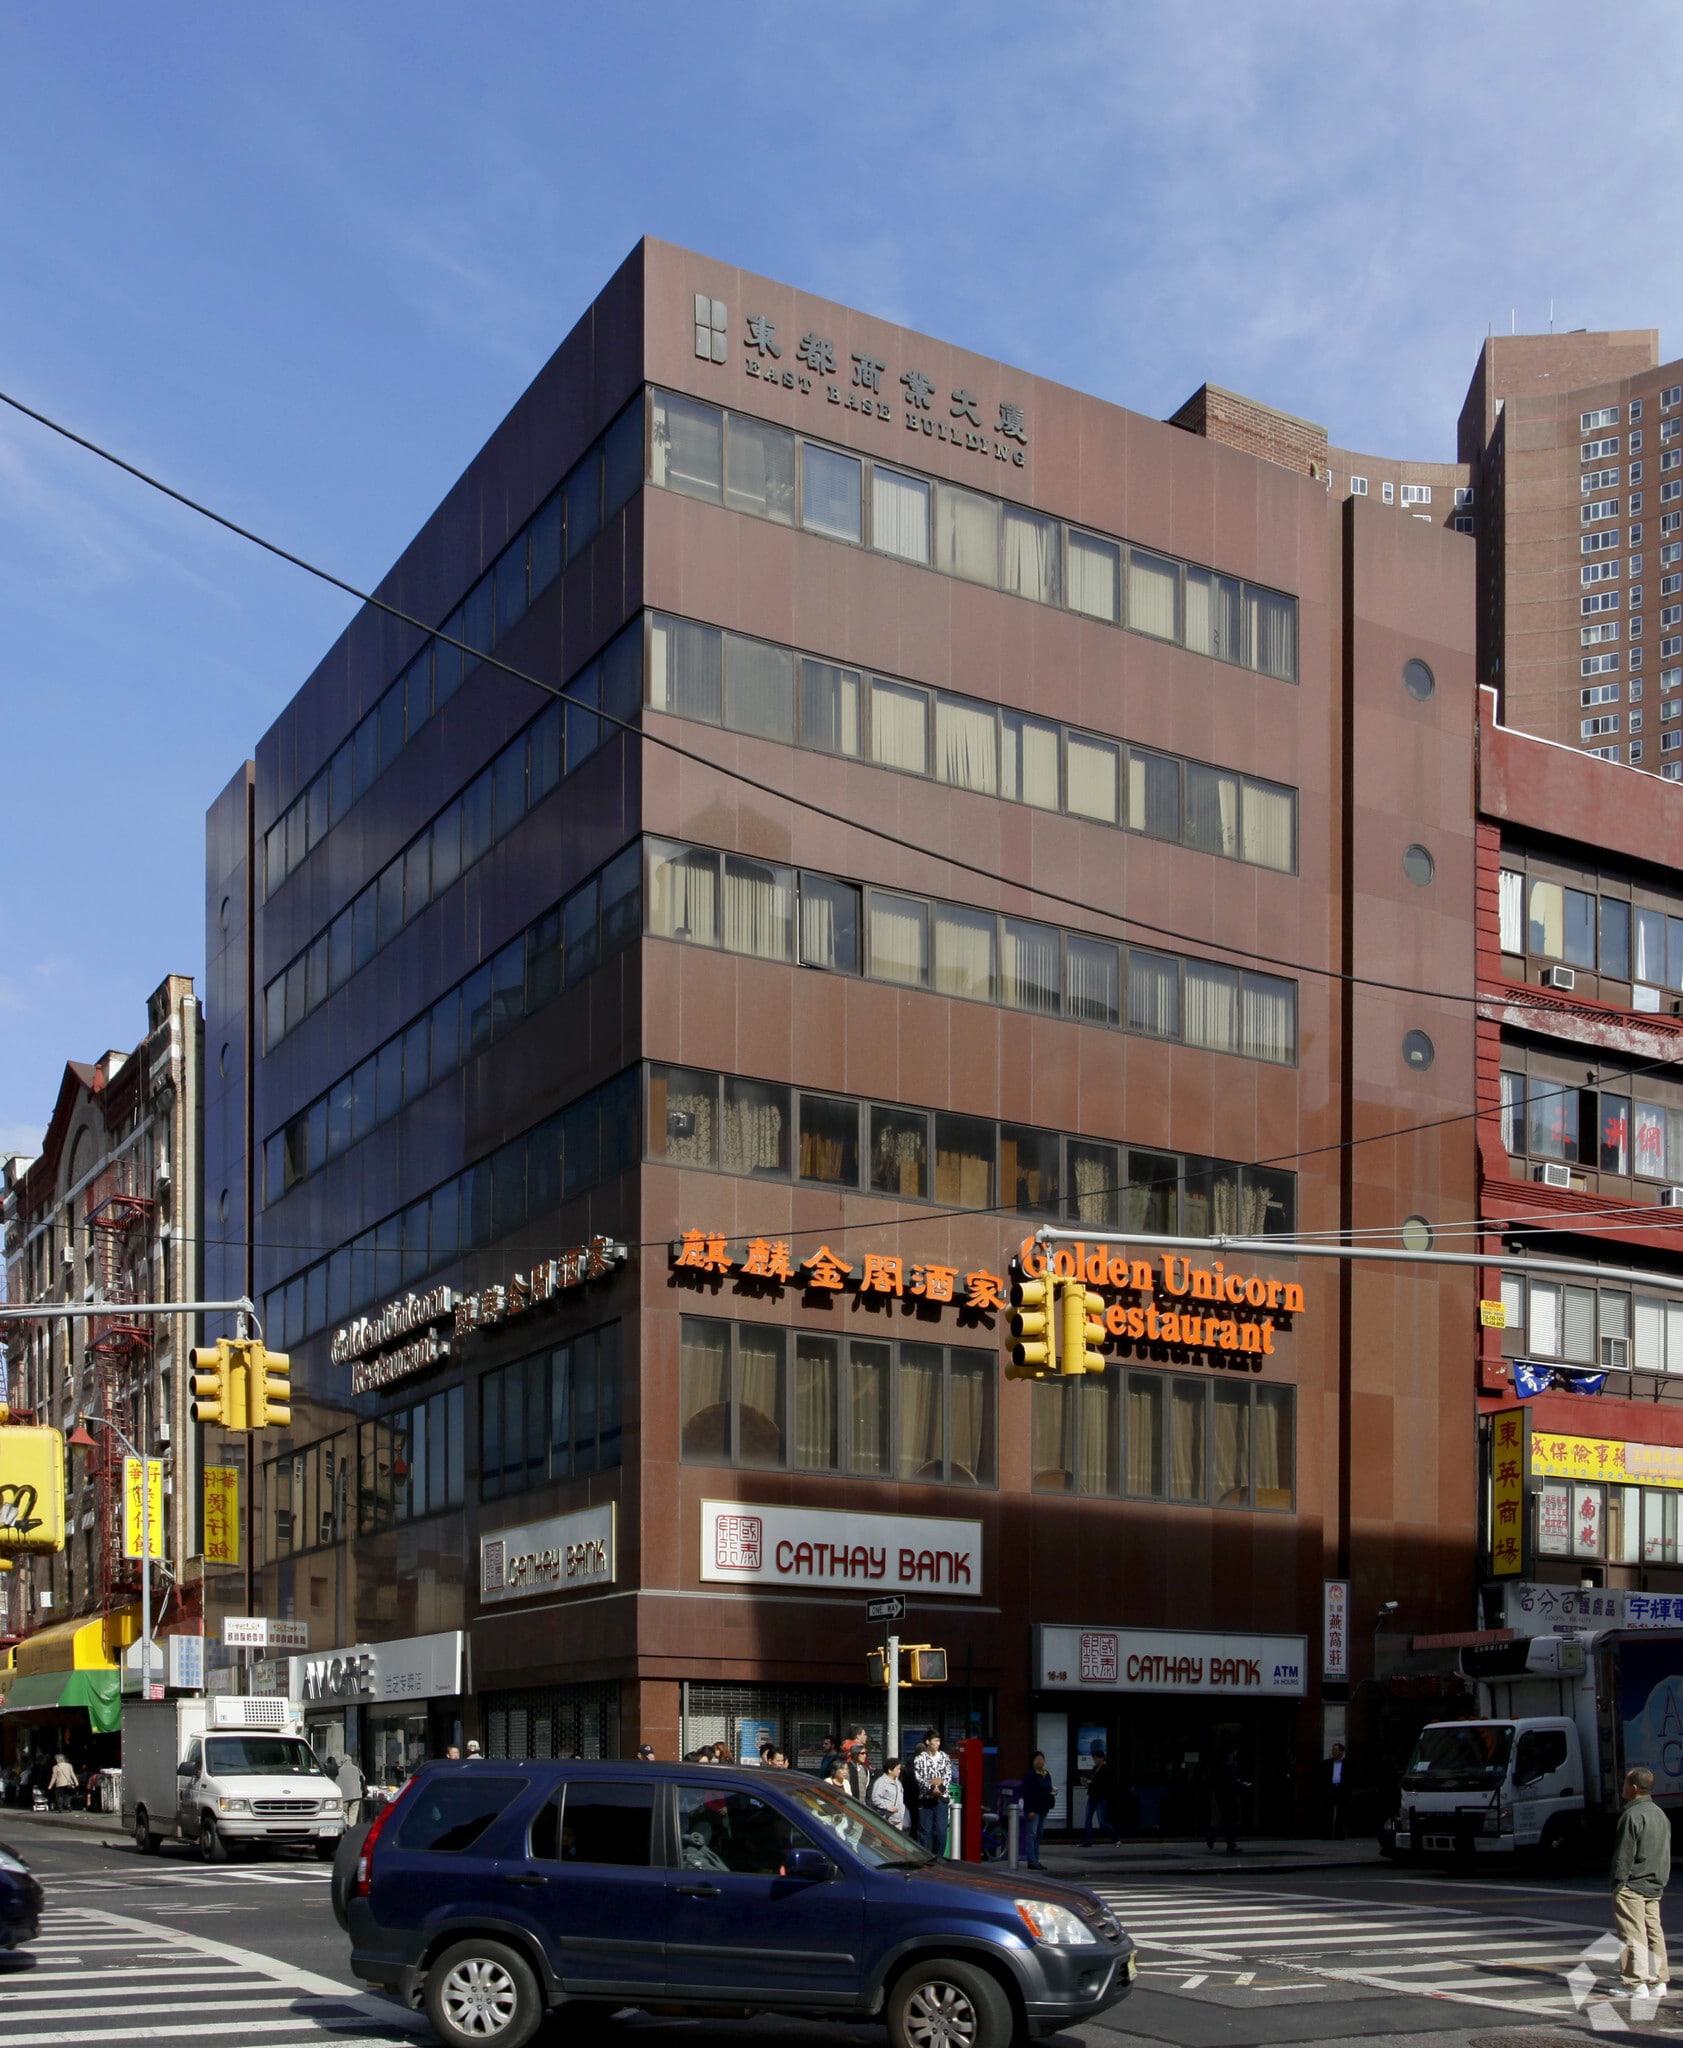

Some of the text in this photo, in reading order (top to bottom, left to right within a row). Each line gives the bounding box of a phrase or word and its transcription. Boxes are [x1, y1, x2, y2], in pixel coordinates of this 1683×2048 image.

[745, 358, 1027, 468] EAST BASE BUILDING
[674, 1228, 1007, 1310] 麒麟金閣酒家
[1019, 1235, 1306, 1313] Golden Unicorn
[331, 1285, 452, 1366] Golden Unicorn
[1085, 1300, 1276, 1355] estaurant
[351, 1328, 440, 1396] Restaurant
[1495, 1420, 1520, 1566] 東英商場
[509, 1547, 560, 1588] CATHAY
[566, 1537, 607, 1579] BANK
[775, 1540, 971, 1585] CATHAY BANK
[871, 1603, 899, 1616] ONE WAY
[1545, 1614, 1566, 1623] 100%
[1127, 1654, 1261, 1685] CATHAY BANK
[1273, 1664, 1299, 1679] ATM
[1475, 1643, 1510, 1654] CARRIER
[1047, 1670, 1068, 1681] 16-18
